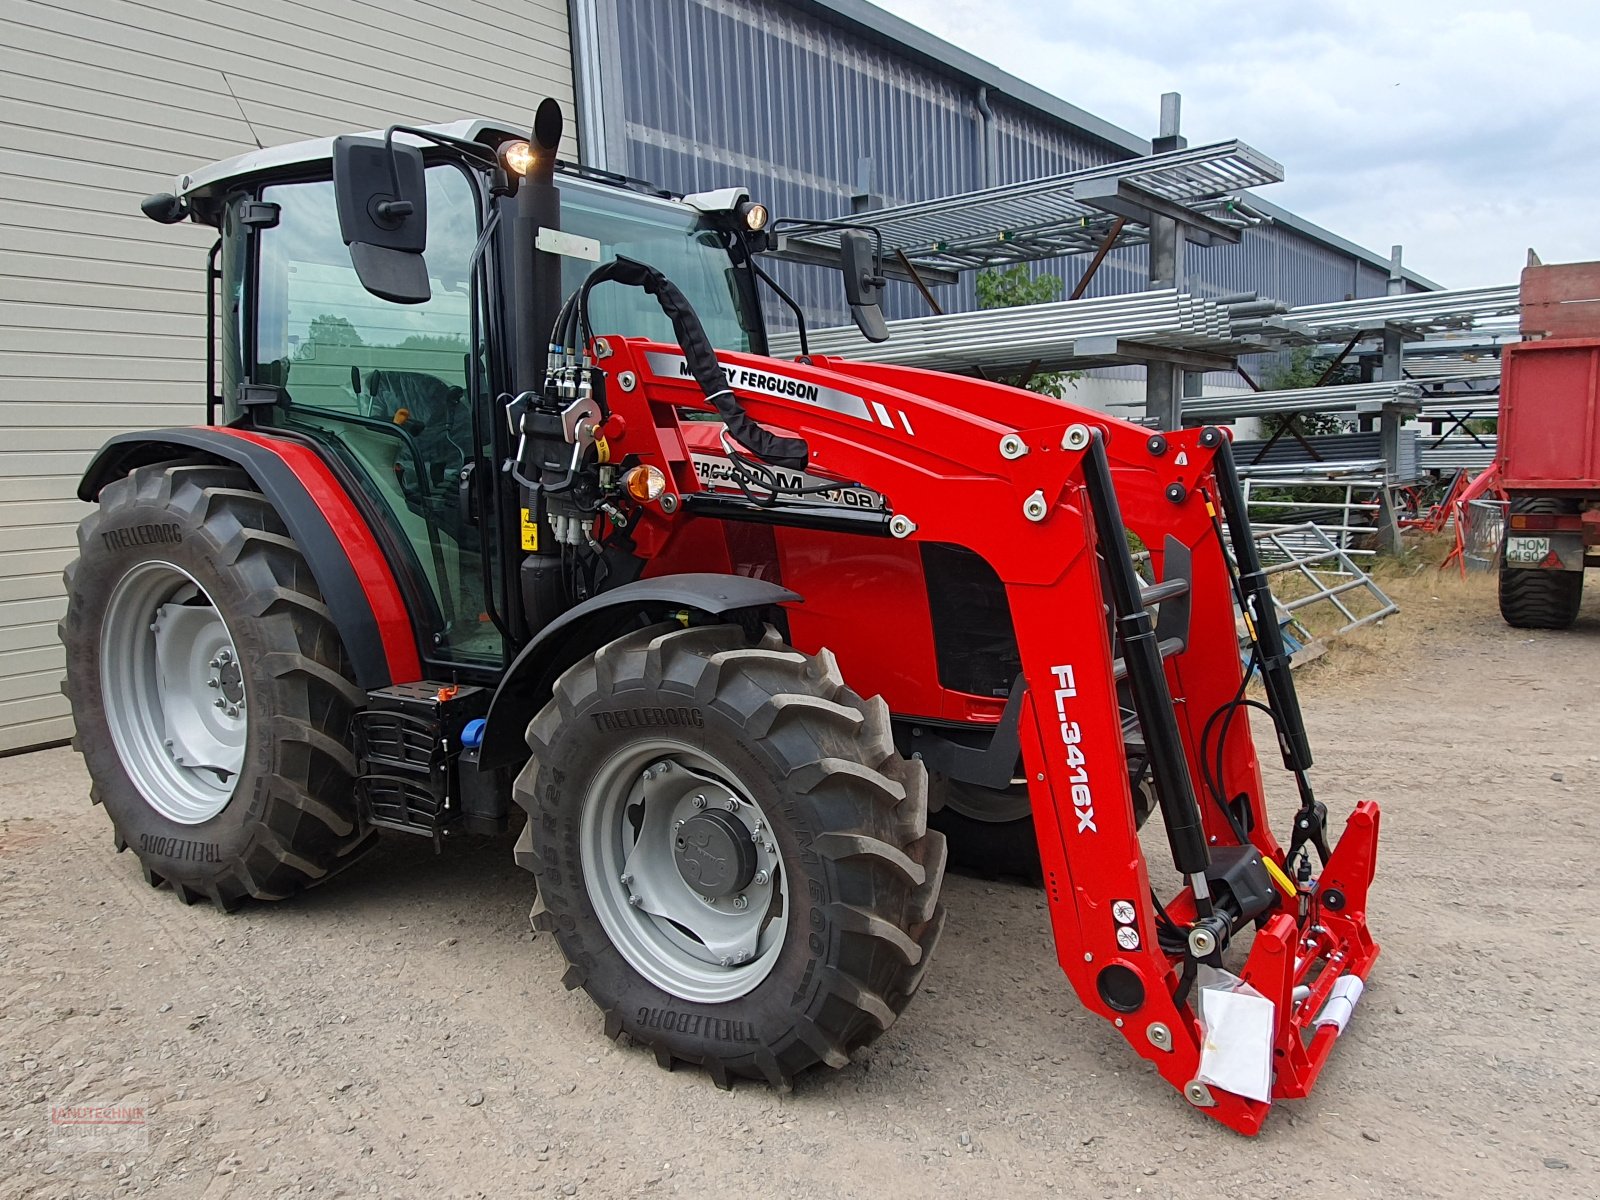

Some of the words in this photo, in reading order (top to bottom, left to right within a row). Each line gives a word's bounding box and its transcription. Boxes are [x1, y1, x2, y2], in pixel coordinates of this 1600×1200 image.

[740, 371, 819, 402] FERGUSON
[776, 472, 804, 498] M
[101, 523, 183, 553] TRELLEBORG
[1517, 539, 1548, 551] HOM
[590, 706, 705, 735] TRELLEBORG
[1050, 664, 1098, 834] FL.3416X
[139, 832, 223, 863] TRELLEBORG
[636, 1006, 761, 1042] TRELLEBORG
